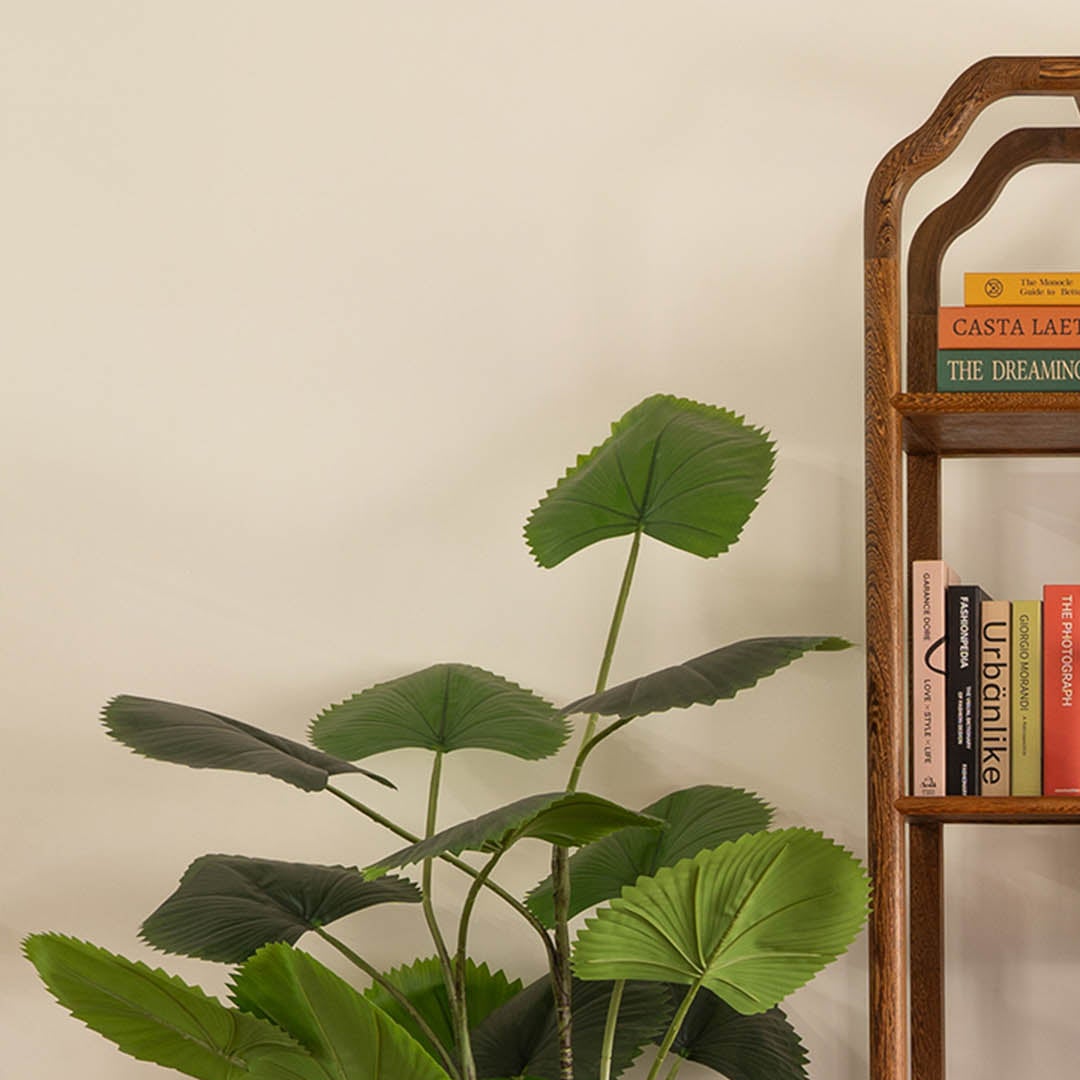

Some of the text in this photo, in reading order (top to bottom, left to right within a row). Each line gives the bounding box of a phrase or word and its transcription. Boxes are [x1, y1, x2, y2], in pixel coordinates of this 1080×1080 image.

[1019, 288, 1044, 296] Guide
[1020, 278, 1038, 286] The
[952, 318, 1025, 336] CASTA
[947, 359, 984, 381] THE
[960, 596, 969, 669] FASHIONPEDIA
[1019, 614, 1030, 660] GIORGIO
[1061, 595, 1073, 707] THE PHOTOGRAPH
[923, 678, 932, 702] LOVE
[1019, 662, 1030, 711] MORANDI
[983, 621, 1007, 785] Urbänlike
[923, 711, 932, 737] STYLE
[924, 746, 932, 764] LIFE
